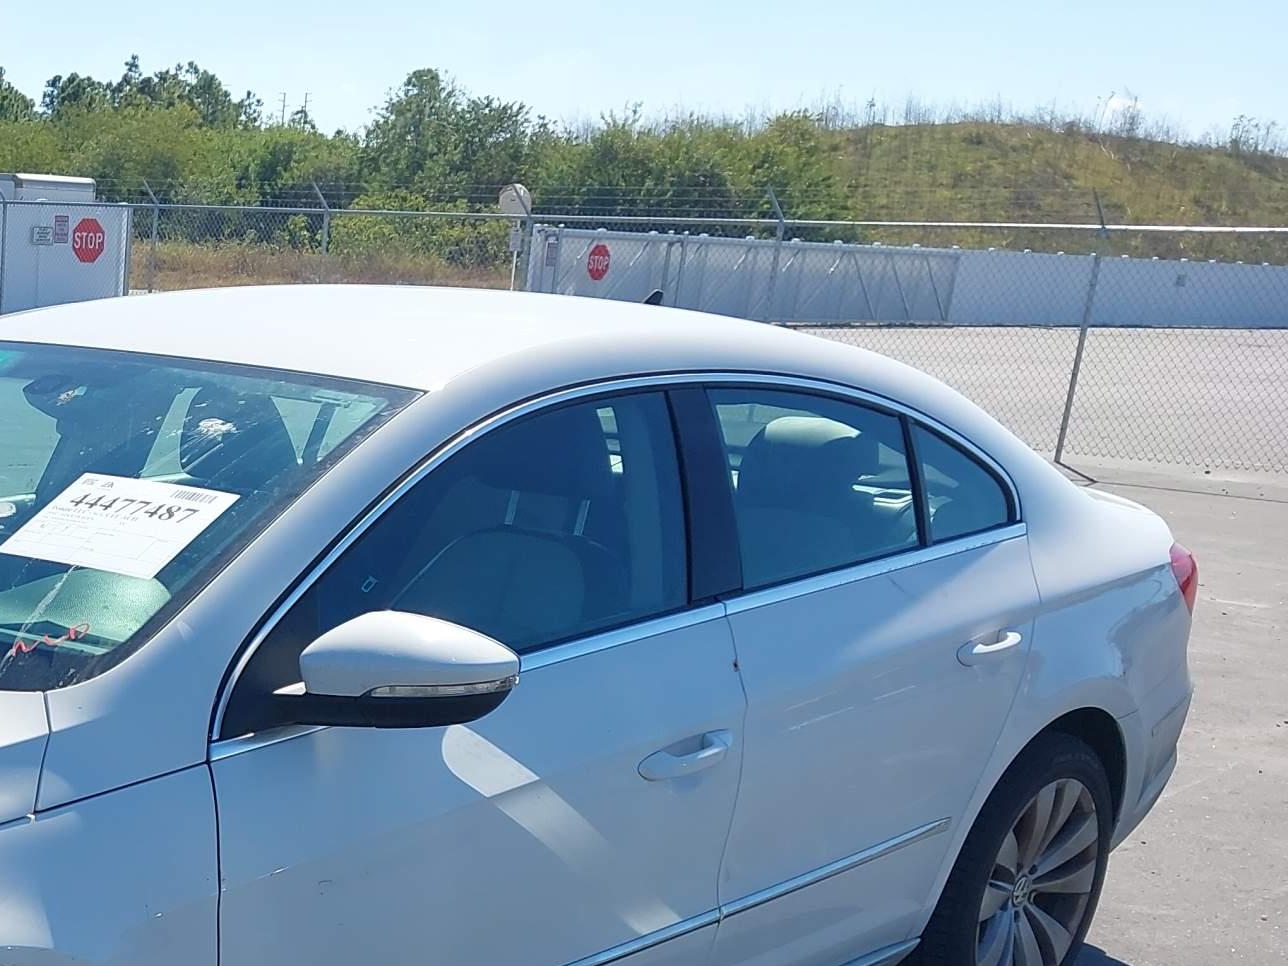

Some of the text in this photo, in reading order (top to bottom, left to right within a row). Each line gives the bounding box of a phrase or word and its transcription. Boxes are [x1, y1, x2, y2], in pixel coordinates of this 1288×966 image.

[74, 233, 103, 249] STOP
[589, 255, 609, 272] STOP
[70, 492, 200, 524] 44477487
